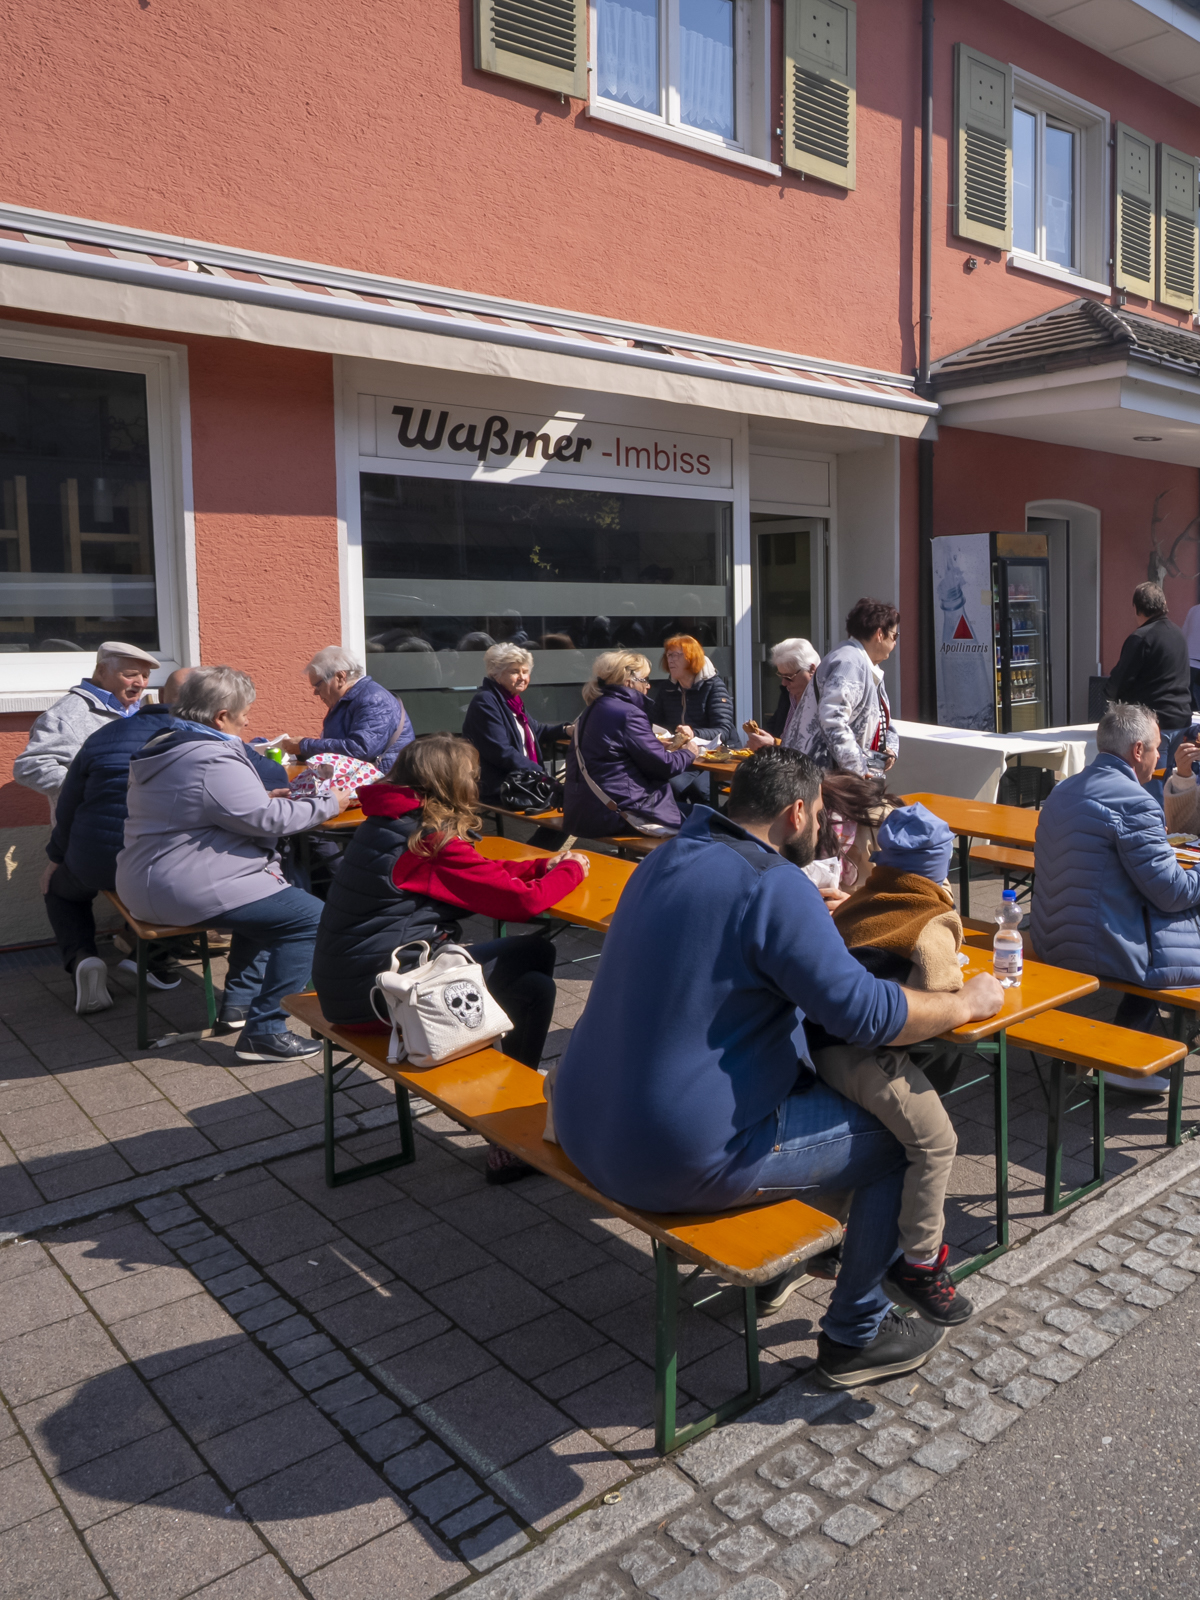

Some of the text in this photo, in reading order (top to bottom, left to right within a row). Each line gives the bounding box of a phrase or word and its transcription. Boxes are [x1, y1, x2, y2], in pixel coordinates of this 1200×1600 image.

[391, 404, 711, 476] Waßmer -Imbiss
[940, 642, 989, 655] Apollinaris
